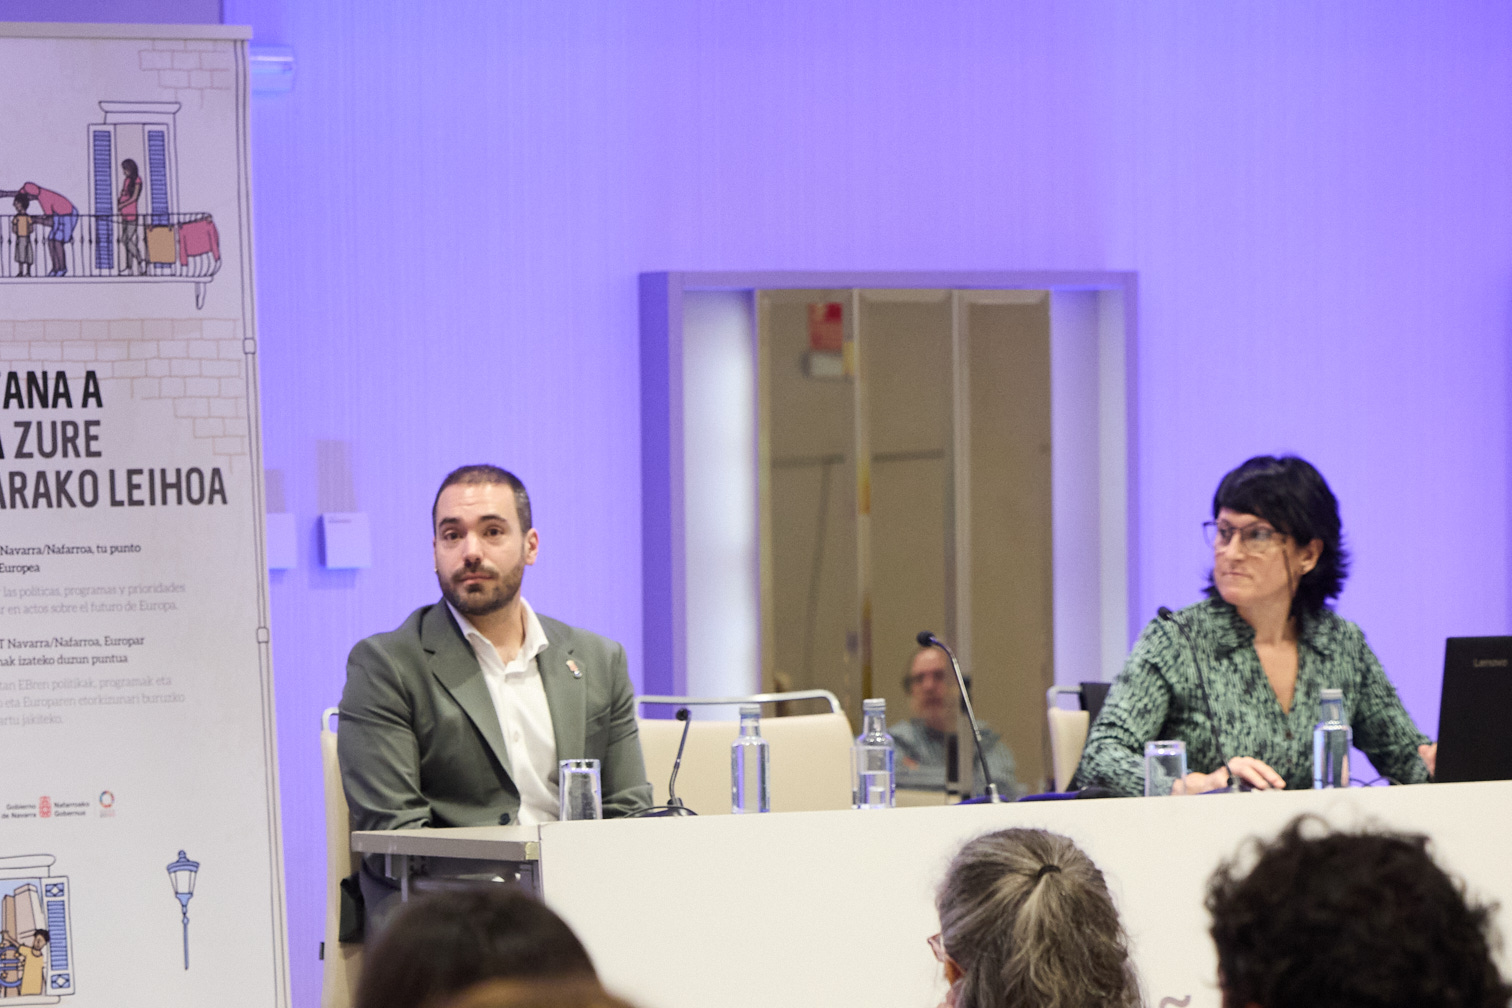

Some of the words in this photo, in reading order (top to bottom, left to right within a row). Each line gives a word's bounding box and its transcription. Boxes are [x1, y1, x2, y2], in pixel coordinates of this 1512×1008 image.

[81, 370, 103, 408] A
[14, 420, 102, 459] ZURE
[109, 468, 228, 507] LEIHOA
[96, 545, 108, 554] tu
[109, 544, 142, 555] punto
[3, 586, 18, 597] las
[63, 586, 117, 598] programas
[118, 586, 126, 595] y
[128, 583, 186, 596] prioridades
[7, 606, 21, 615] en
[50, 602, 78, 613] sobre
[79, 602, 88, 612] el
[90, 601, 123, 612] futuro
[125, 600, 137, 611] de
[104, 635, 145, 648] Europar
[18, 655, 55, 666] izateko
[91, 655, 128, 666] puntua
[155, 675, 172, 686] eta
